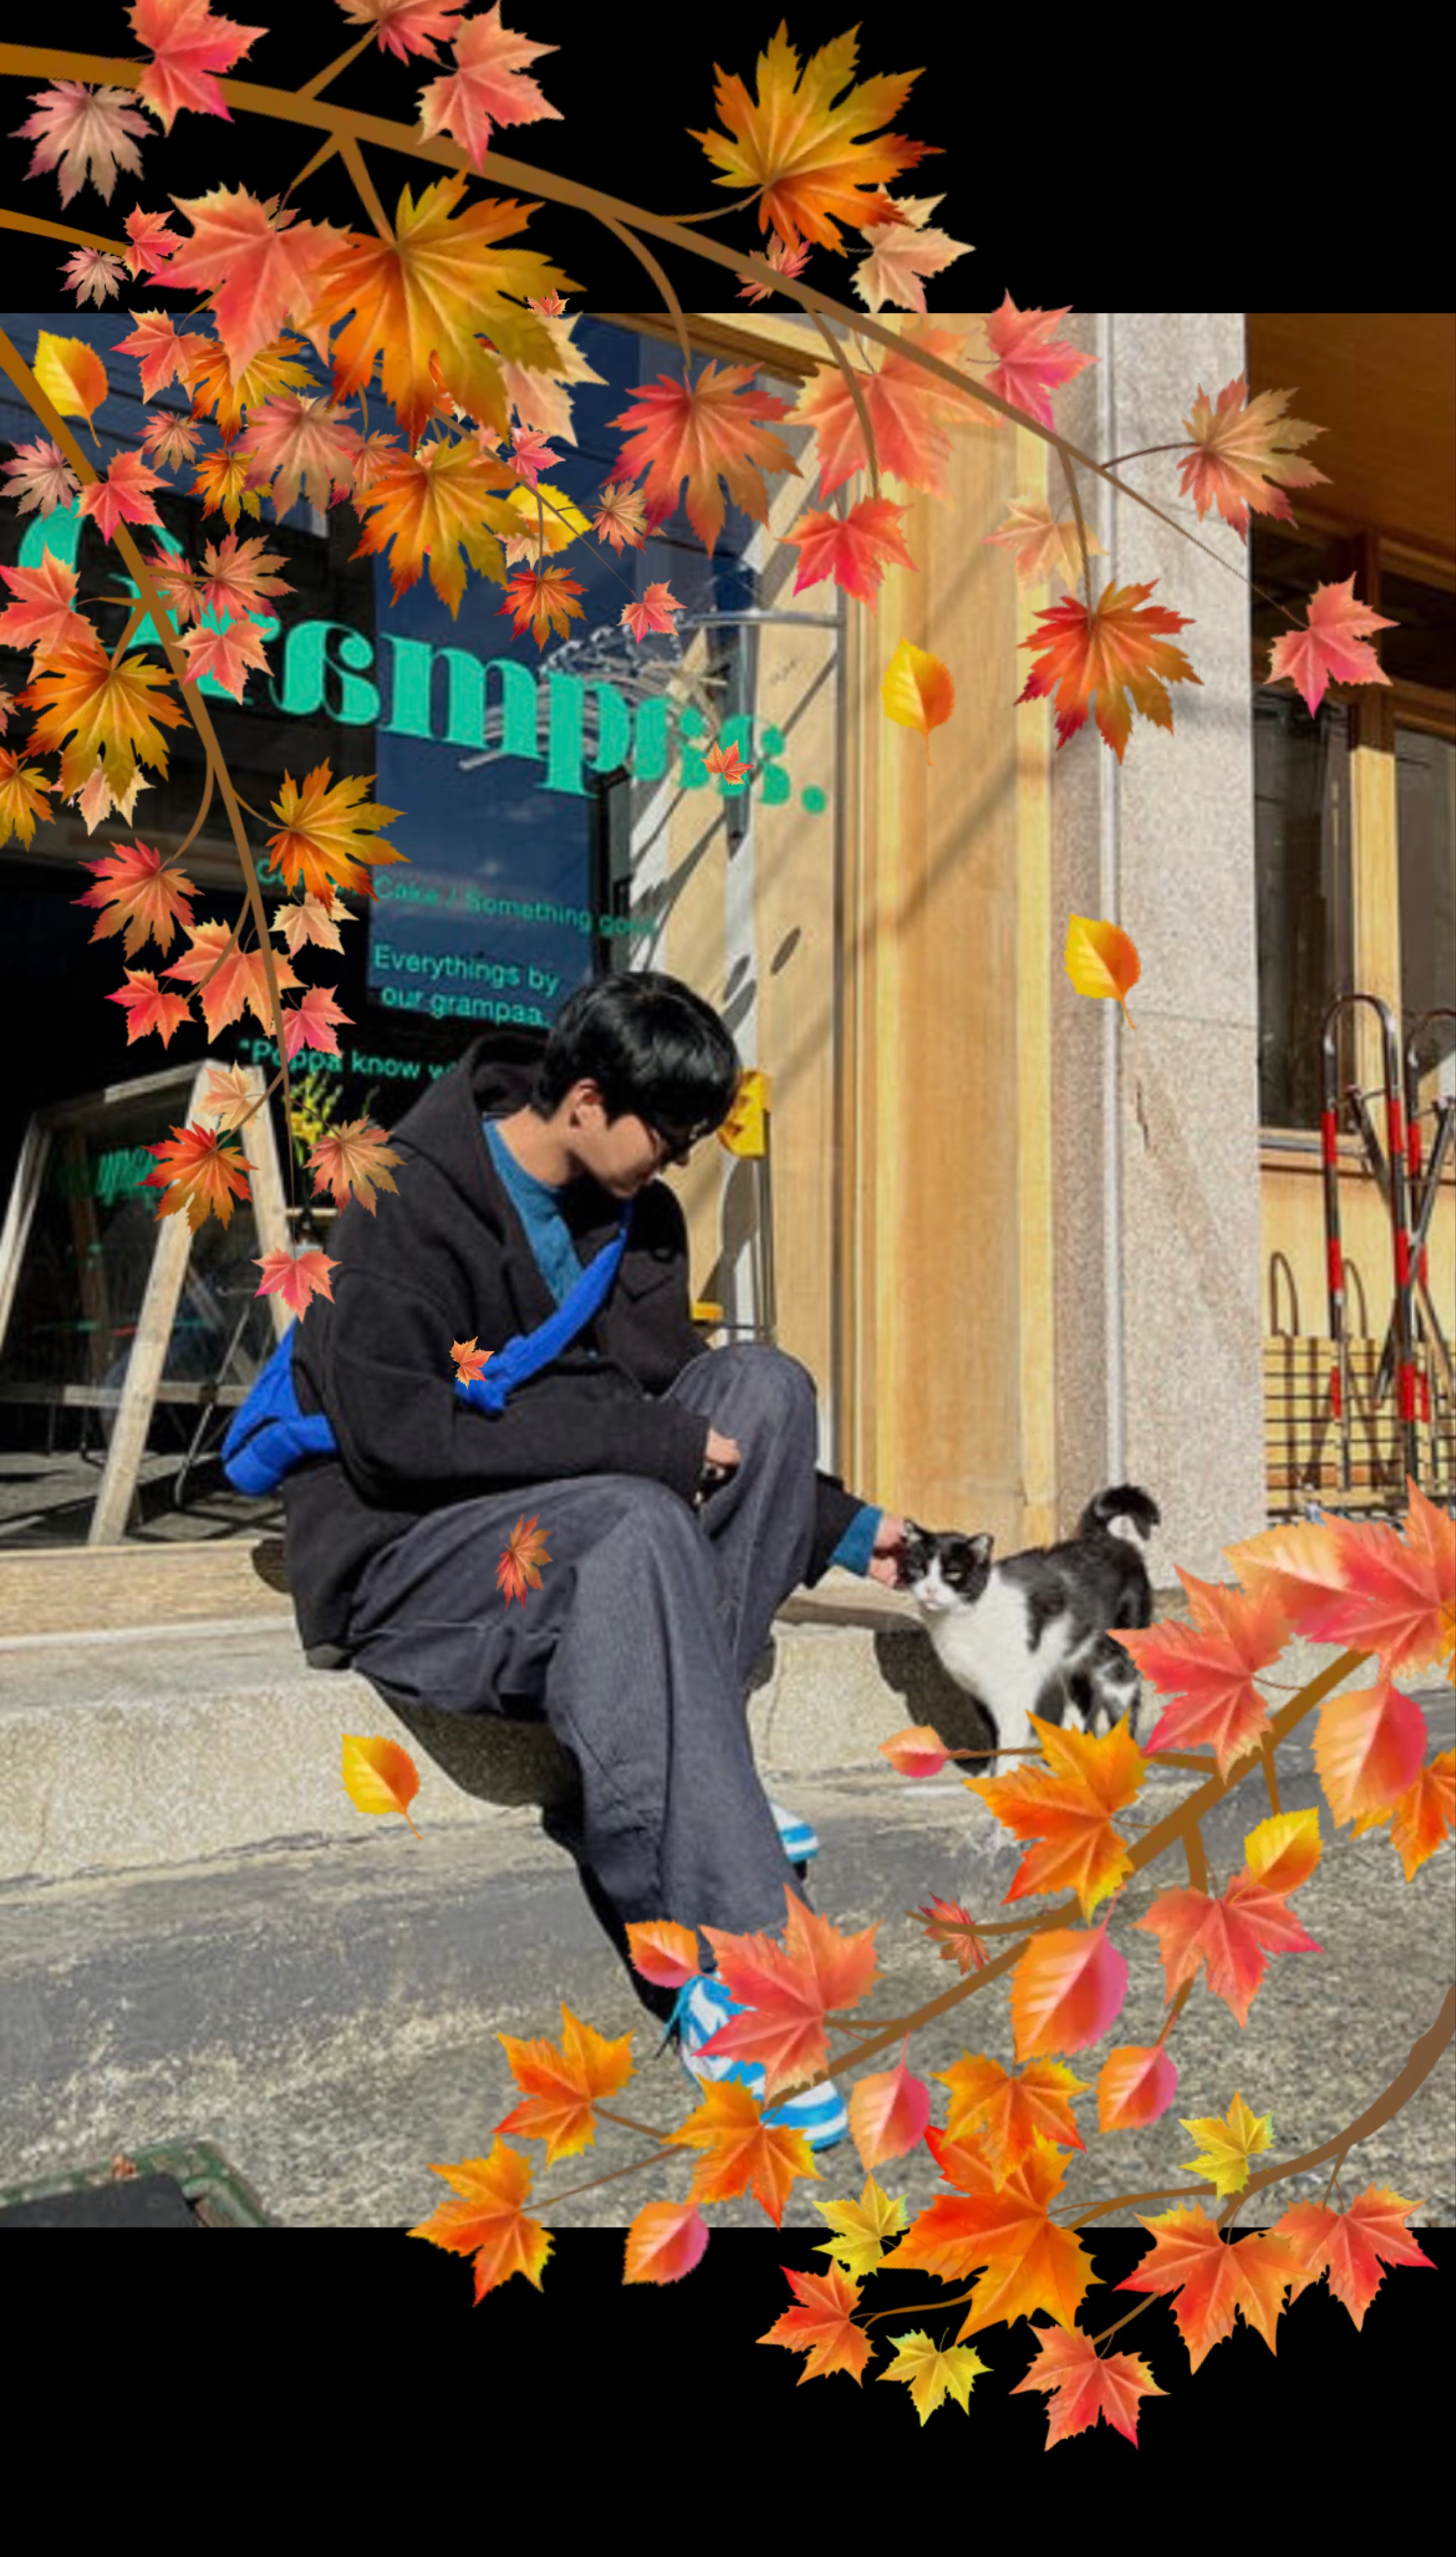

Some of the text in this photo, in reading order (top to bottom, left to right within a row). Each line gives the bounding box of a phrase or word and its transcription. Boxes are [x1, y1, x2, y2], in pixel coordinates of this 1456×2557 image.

[466, 885, 592, 934] Something
[374, 944, 559, 998] Everythings by
[381, 986, 422, 1009] our
[351, 1049, 420, 1079] know
